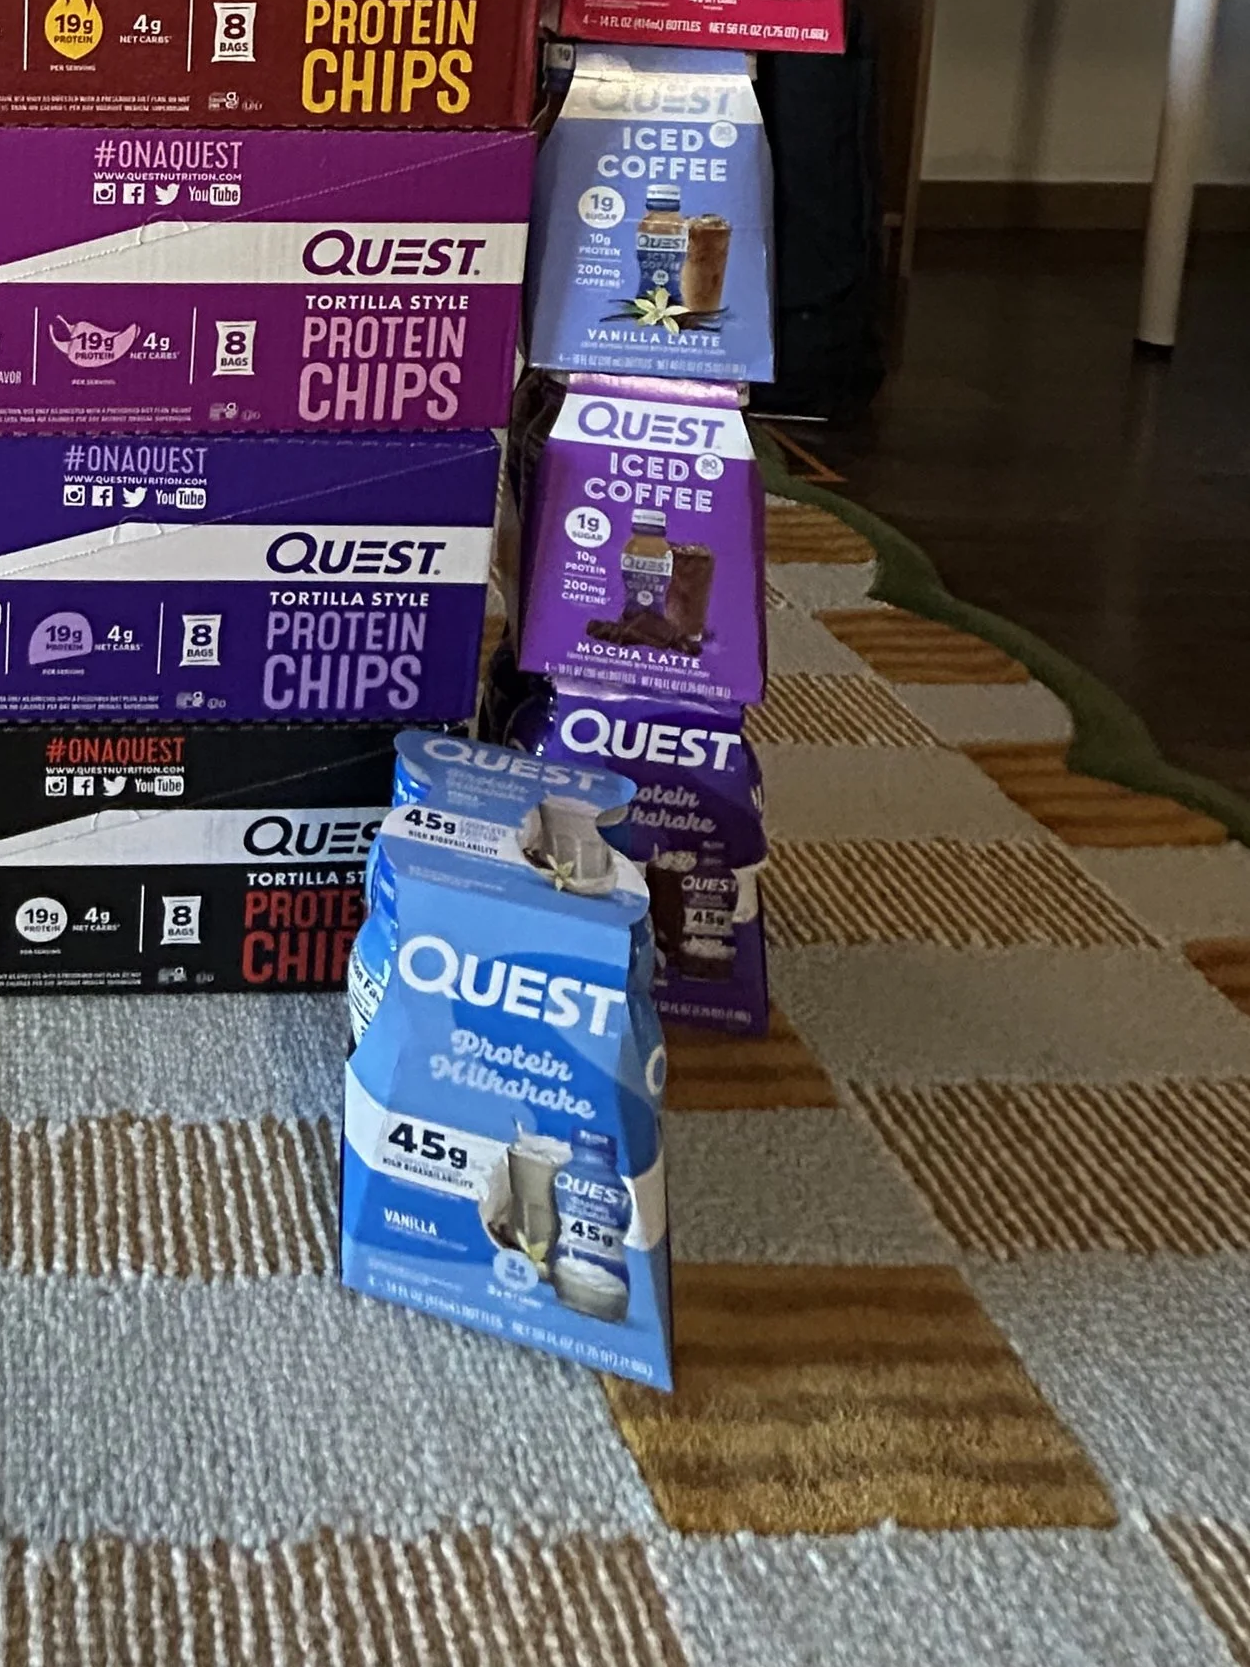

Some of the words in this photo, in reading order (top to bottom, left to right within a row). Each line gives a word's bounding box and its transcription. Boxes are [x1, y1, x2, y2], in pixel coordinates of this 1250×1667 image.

[54, 14, 93, 34] 19g
[133, 14, 161, 33] 4g
[224, 14, 246, 39] 8
[304, 0, 477, 44] PROTEIN
[54, 35, 92, 43] PROTEIN
[220, 43, 248, 52] BAGS
[302, 50, 473, 113] CHIPS
[623, 127, 703, 152] ICED
[94, 142, 243, 170] #ONAQUEST
[598, 156, 727, 182] COFFEE
[302, 230, 486, 276] QUEST
[305, 295, 403, 310] TORTILLA
[410, 295, 469, 311] STYLE
[225, 332, 246, 355] 8
[301, 316, 465, 359] PROTEIN
[587, 328, 661, 343] VANILLA
[668, 333, 720, 347] LATTE
[298, 363, 462, 422] CHIPS
[578, 401, 724, 449] QUEST
[65, 446, 207, 474] #ONAQUEST
[609, 452, 689, 481] ICED
[584, 478, 712, 512] COFFEE
[266, 531, 446, 575] QUEST
[271, 591, 365, 606] TORTILLA
[372, 592, 429, 606] STYLE
[190, 625, 212, 646] 8
[266, 612, 425, 651] PROTEIN
[577, 642, 641, 661] MOCHA
[648, 653, 700, 669] LATTE
[264, 655, 422, 710] CHIPS
[46, 738, 185, 764] #ONAQUEST
[560, 708, 741, 771] QUEST
[405, 808, 456, 835] 45g
[247, 872, 339, 886] TORTILLA
[24, 908, 59, 926] 19g
[85, 907, 110, 925] 4g
[171, 907, 192, 925] 8
[692, 912, 724, 926] 45g
[398, 935, 626, 1037] QUEST
[450, 1028, 573, 1082] Protein
[388, 1122, 468, 1170] 45g
[384, 1208, 437, 1236] VANILLA
[571, 1220, 614, 1248] 45g
